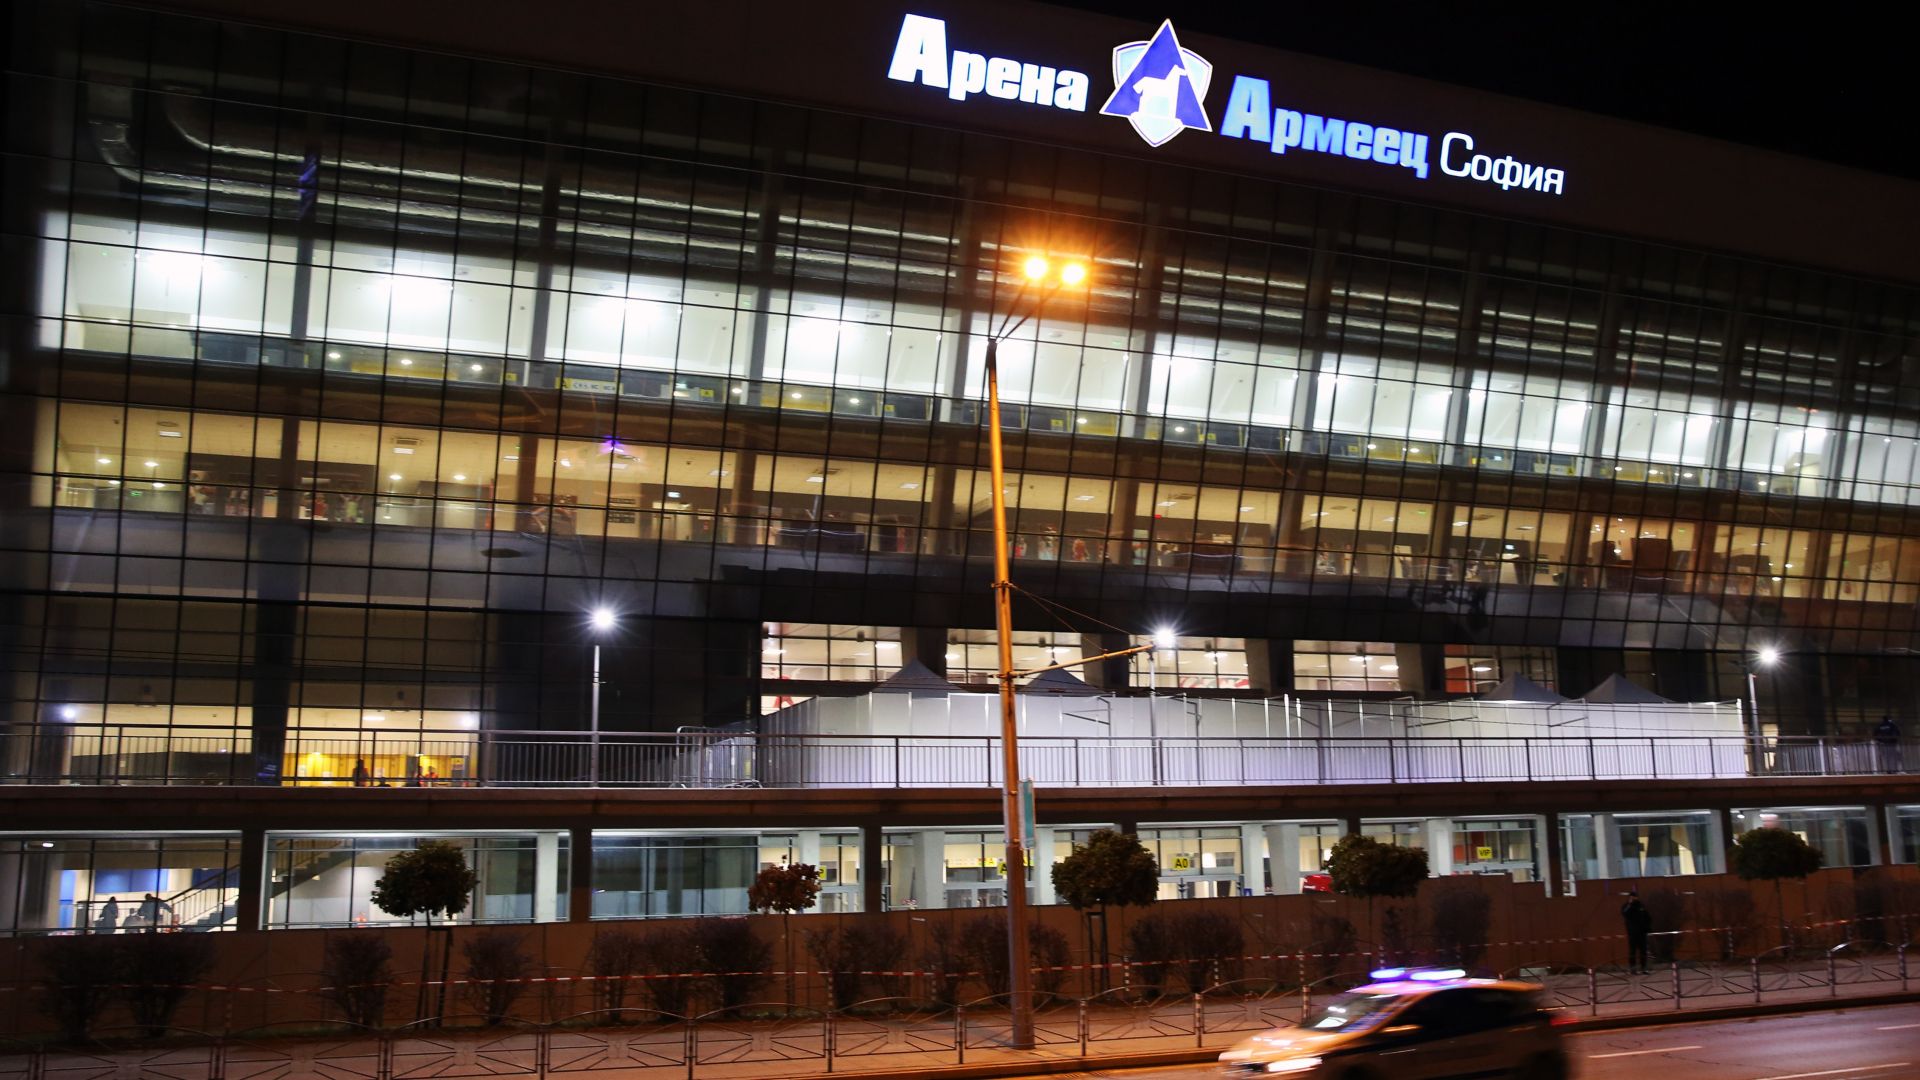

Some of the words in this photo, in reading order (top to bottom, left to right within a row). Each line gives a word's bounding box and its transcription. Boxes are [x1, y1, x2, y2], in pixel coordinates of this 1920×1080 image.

[887, 13, 1090, 112] Арена
[1219, 75, 1431, 180] Армеец
[1439, 132, 1566, 195] София
